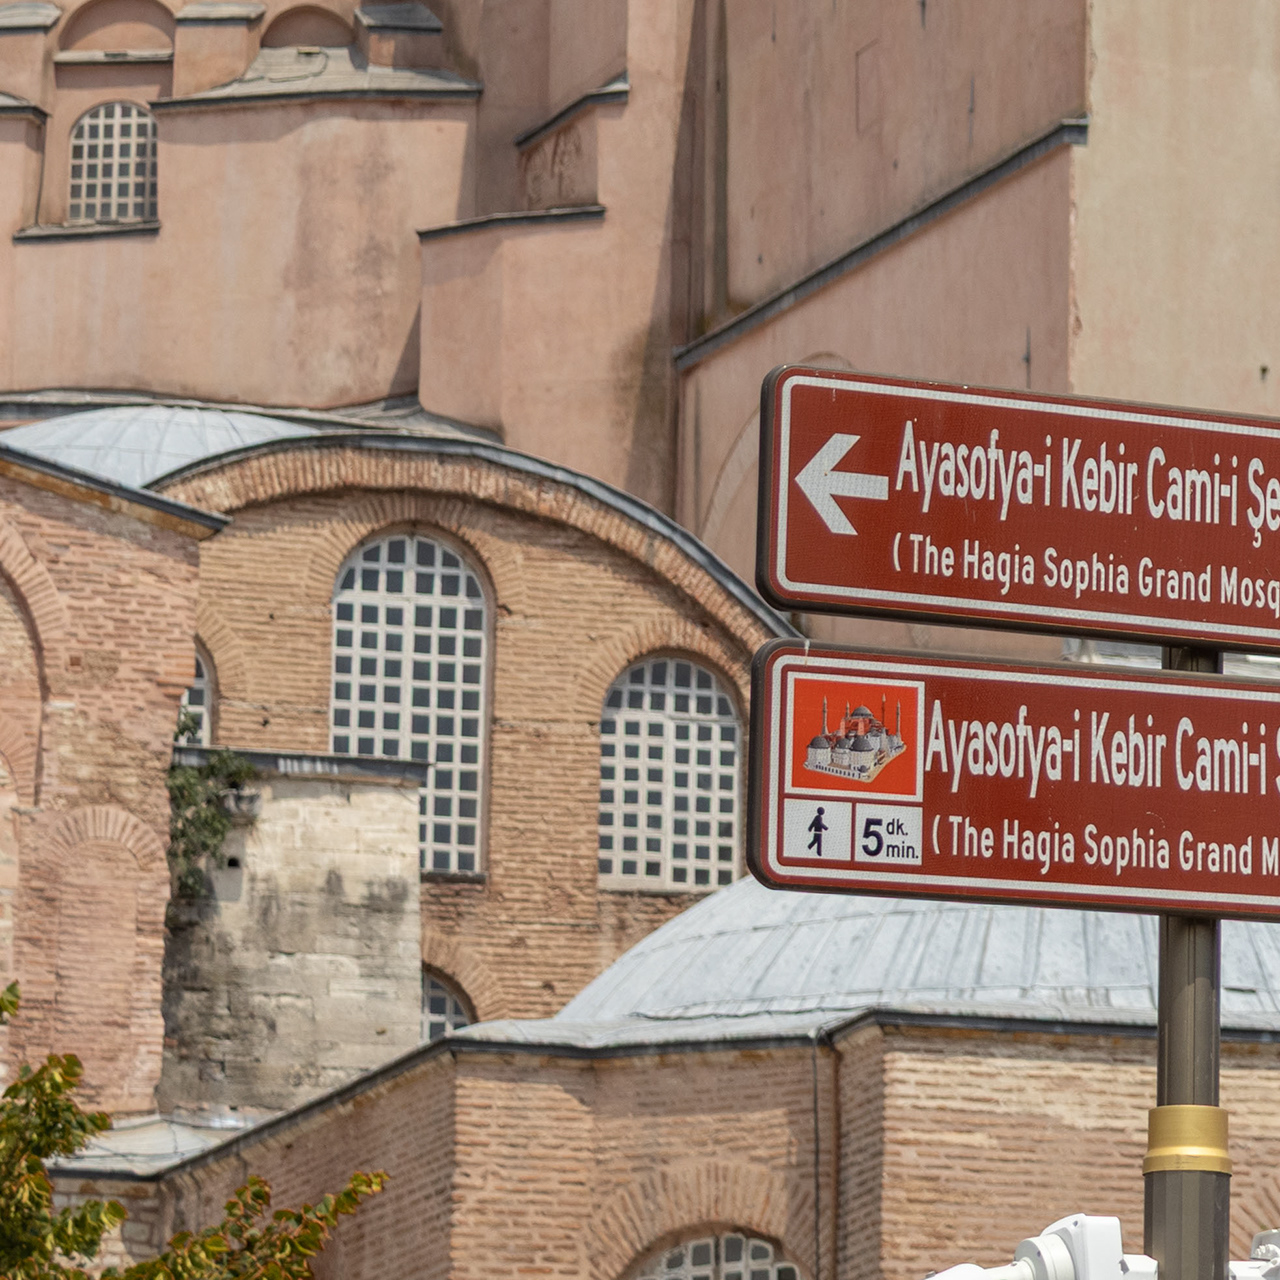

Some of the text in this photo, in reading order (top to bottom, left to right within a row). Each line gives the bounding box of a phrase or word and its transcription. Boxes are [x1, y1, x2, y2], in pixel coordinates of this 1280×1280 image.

[896, 420, 1052, 521] Ayasofya-i
[1061, 438, 1137, 514] Kebir
[1147, 447, 1238, 526] Cami-i
[963, 539, 1035, 595] Hagia
[1044, 547, 1129, 599] Sophia
[1138, 557, 1212, 604] Grand
[925, 699, 1080, 798] Ayasofya-i
[1090, 711, 1166, 788] Kebir
[1173, 717, 1266, 795] Cami-i
[861, 818, 908, 857] 5 dk.
[886, 841, 919, 859] min.
[1003, 819, 1075, 875] Hagia
[1083, 824, 1169, 874] Sophia
[1179, 830, 1253, 875] Grand
